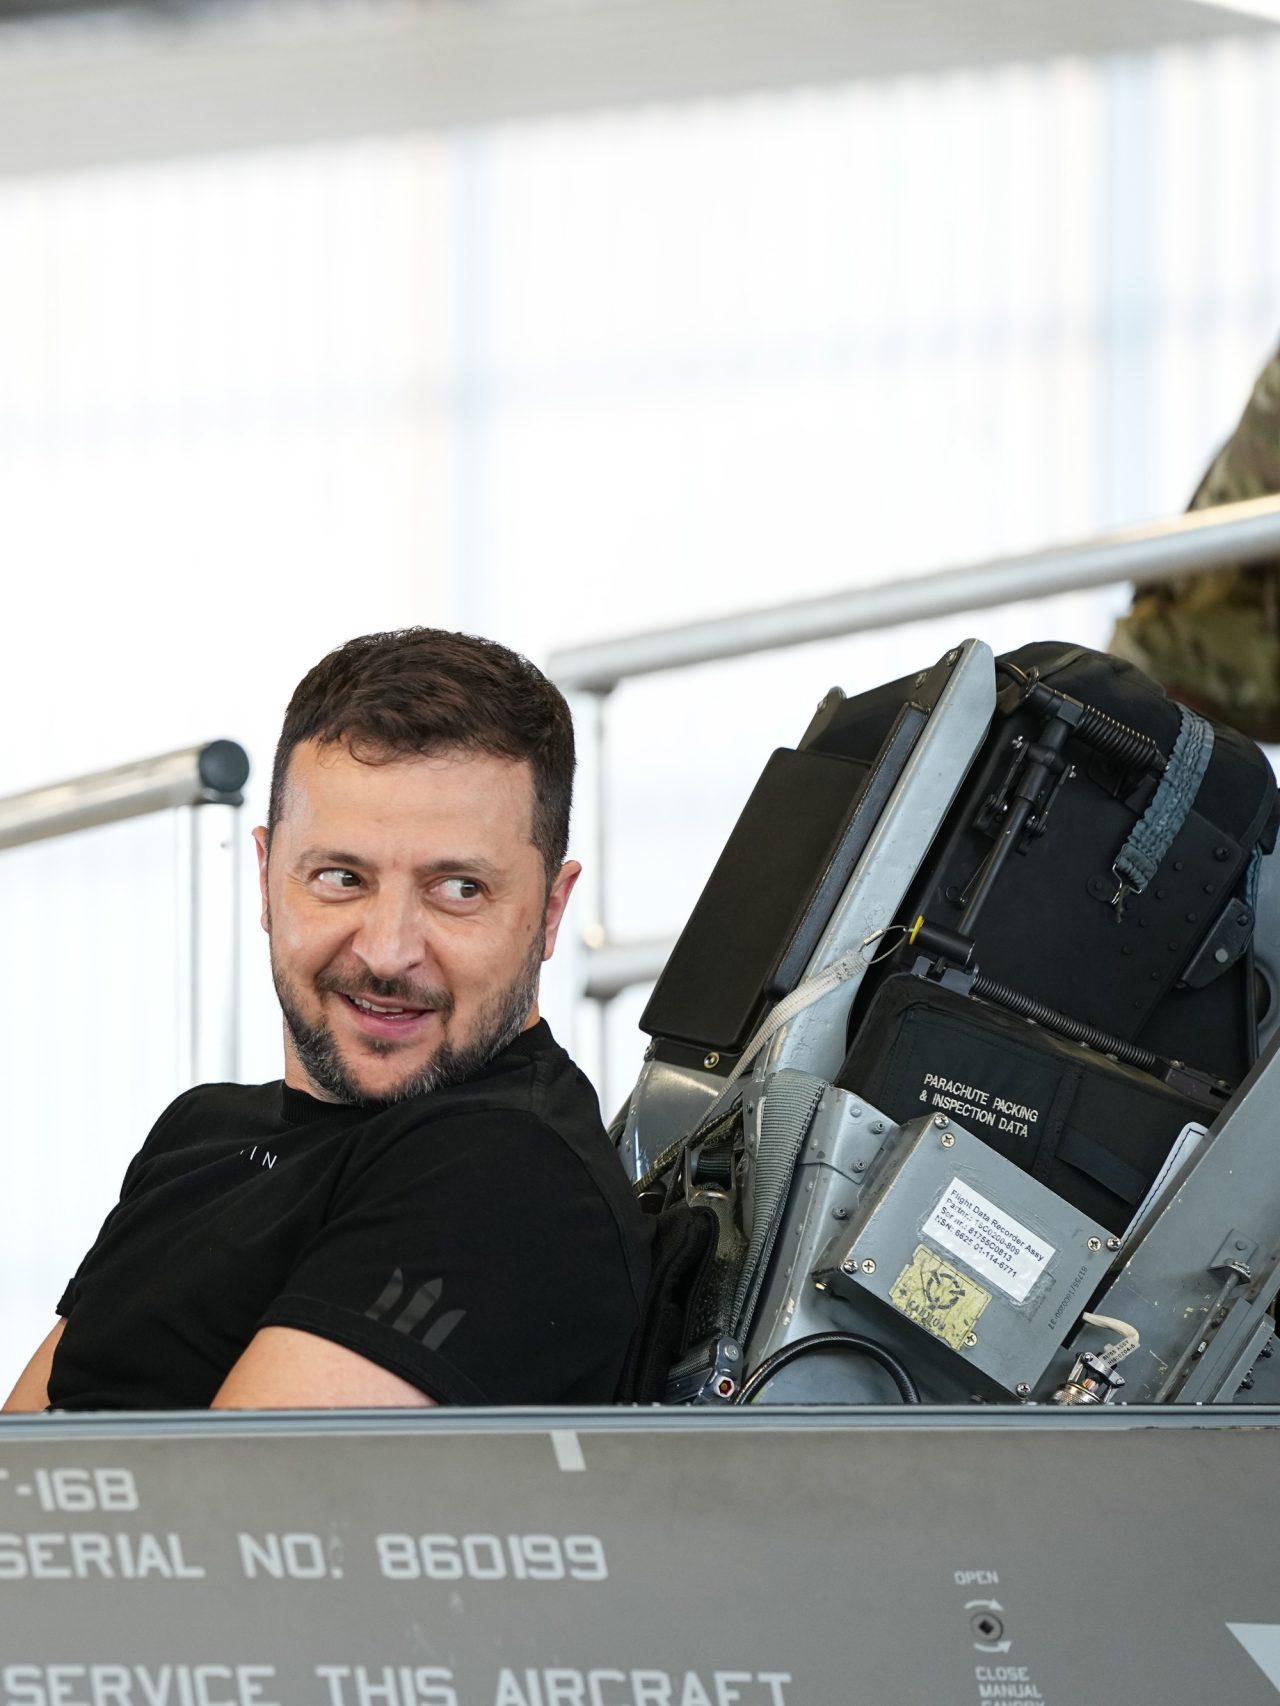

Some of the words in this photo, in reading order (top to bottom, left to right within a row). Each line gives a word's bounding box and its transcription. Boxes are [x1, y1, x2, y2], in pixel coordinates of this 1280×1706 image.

[919, 1089, 928, 1102] &
[932, 1093, 996, 1126] INSPECTION
[998, 1117, 1028, 1138] DATA
[924, 1073, 990, 1106] PARACHUTE
[992, 1097, 1039, 1123] PACKING
[951, 1189, 973, 1209] Flight
[972, 1205, 991, 1222] Data
[991, 1219, 1025, 1247] Recorder
[1025, 1245, 1045, 1262] Assy
[968, 1227, 1013, 1262] 81755C0813
[237, 1531, 343, 1579] NO.
[376, 1533, 609, 1581] 860199
[954, 1570, 999, 1585] OPEN
[3, 1664, 280, 1706] SERVICE
[316, 1666, 458, 1706] THIS
[494, 1667, 791, 1706] AIRCRAFT
[975, 1666, 1030, 1681] CLOSE
[979, 1683, 1042, 1698] MANUAL
